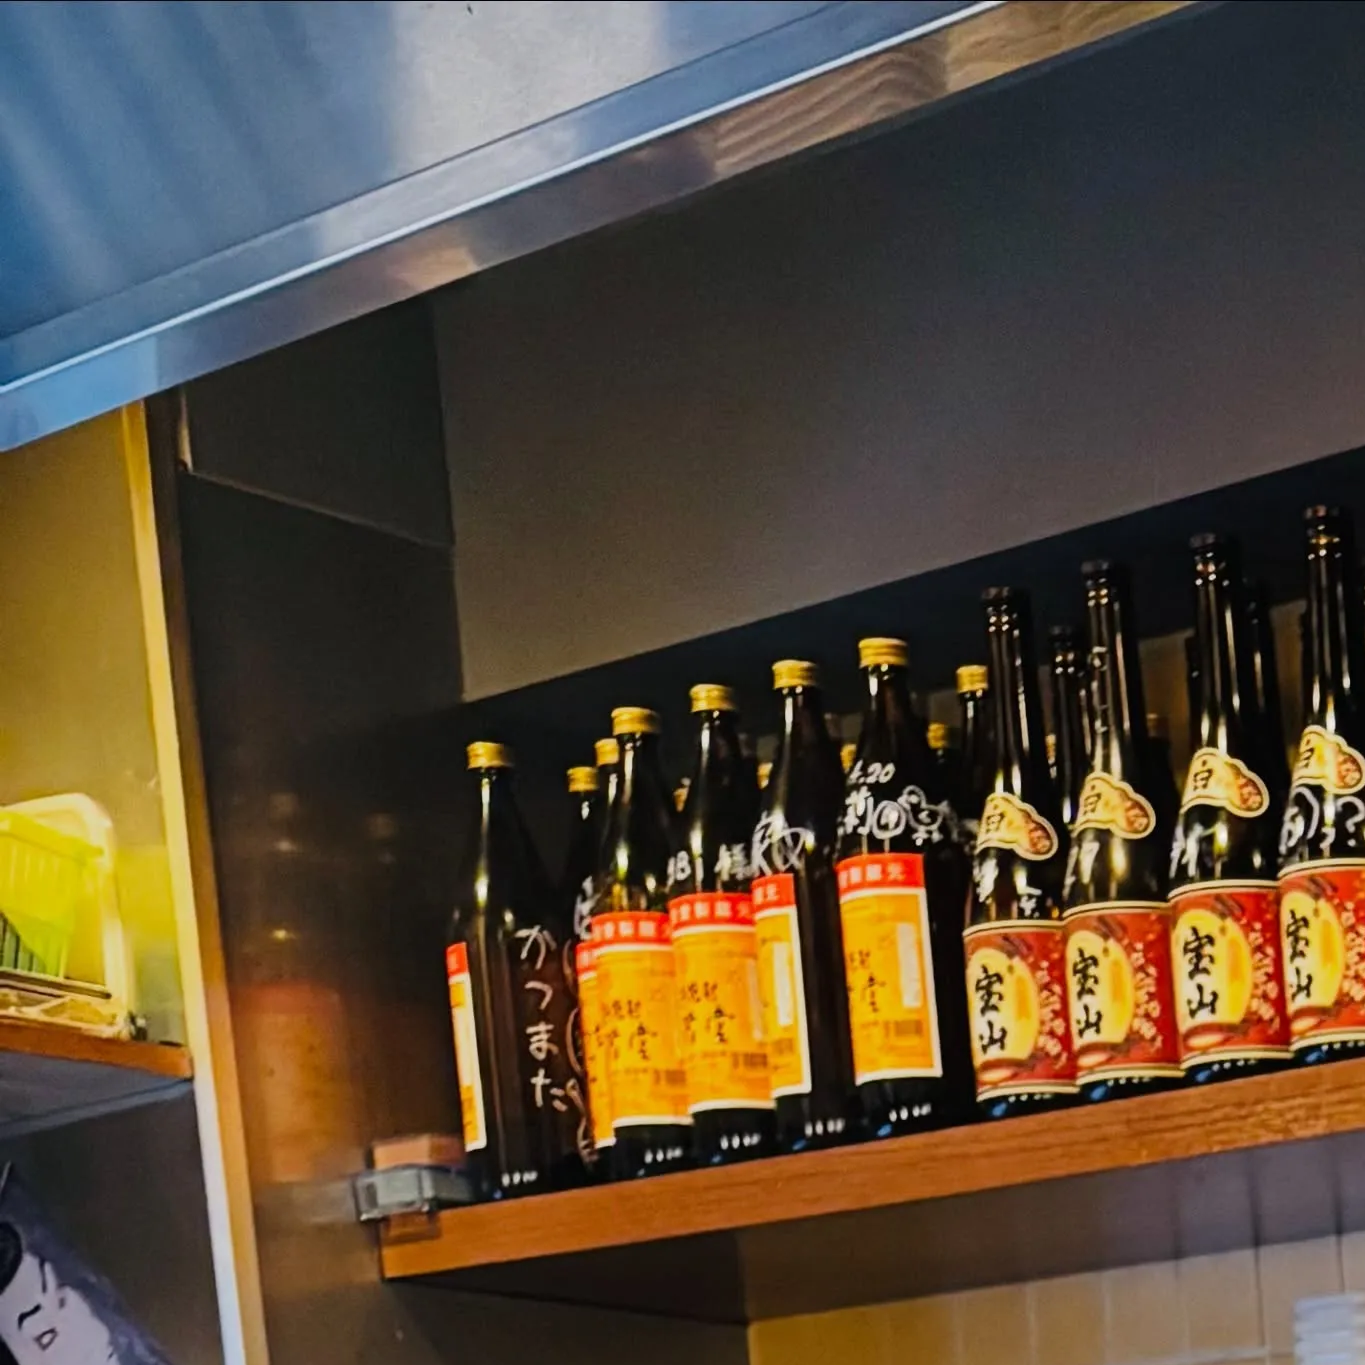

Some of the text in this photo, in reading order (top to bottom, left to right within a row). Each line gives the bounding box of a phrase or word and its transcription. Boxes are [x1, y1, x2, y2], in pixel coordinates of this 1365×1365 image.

[1072, 948, 1103, 1039] 宝山
[1183, 926, 1219, 1018] 宝山
[1286, 909, 1313, 1002] 宝山
[515, 925, 568, 1111] かつまた
[975, 964, 1007, 1054] 宝山
